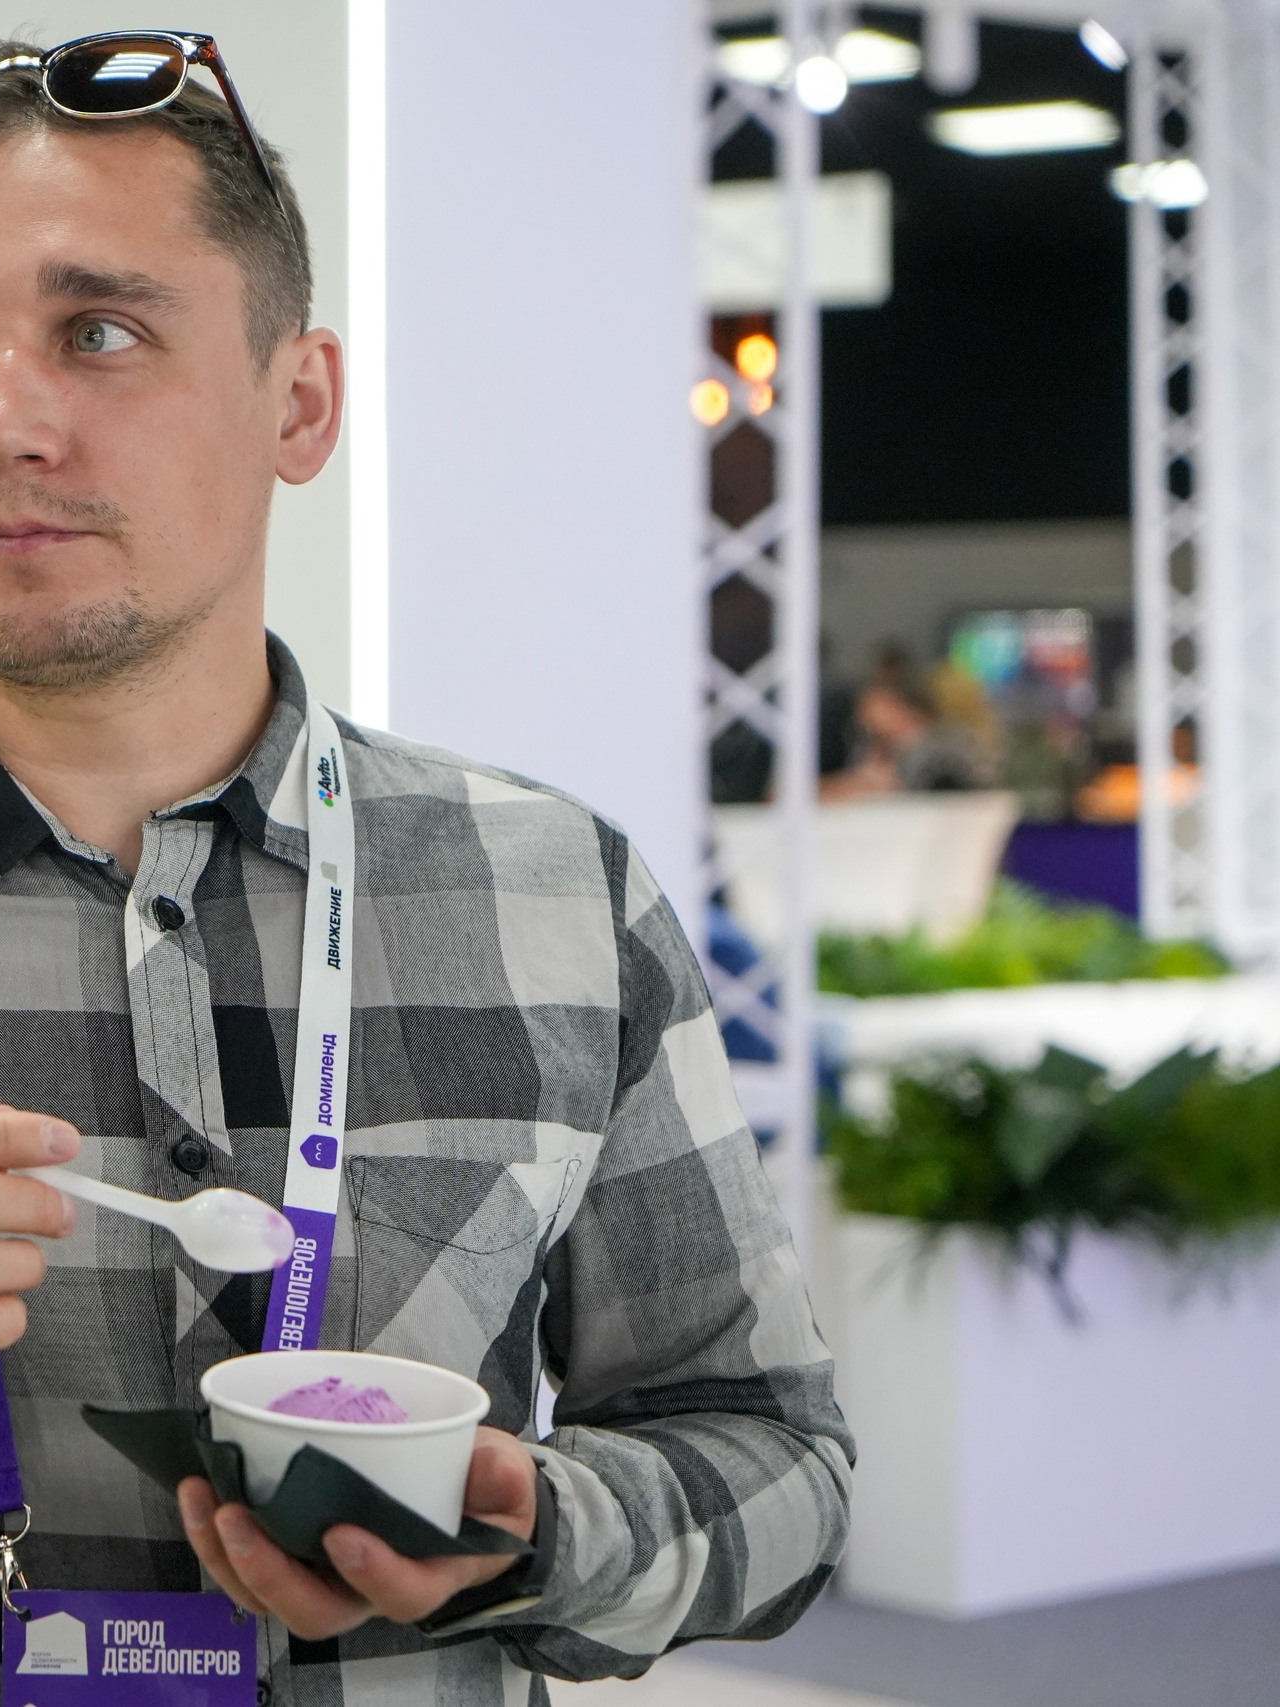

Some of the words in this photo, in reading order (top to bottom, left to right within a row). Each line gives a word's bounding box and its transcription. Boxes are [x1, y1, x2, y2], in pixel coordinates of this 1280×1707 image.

[317, 756, 333, 793] Avito
[327, 886, 342, 970] ДВИЖЕНИЕ
[279, 1237, 317, 1350] ЕВЕЛОПЕРОВ
[103, 1620, 165, 1648] ГОРОД
[101, 1647, 241, 1676] ДЕВЕЛОПЕРОВ
